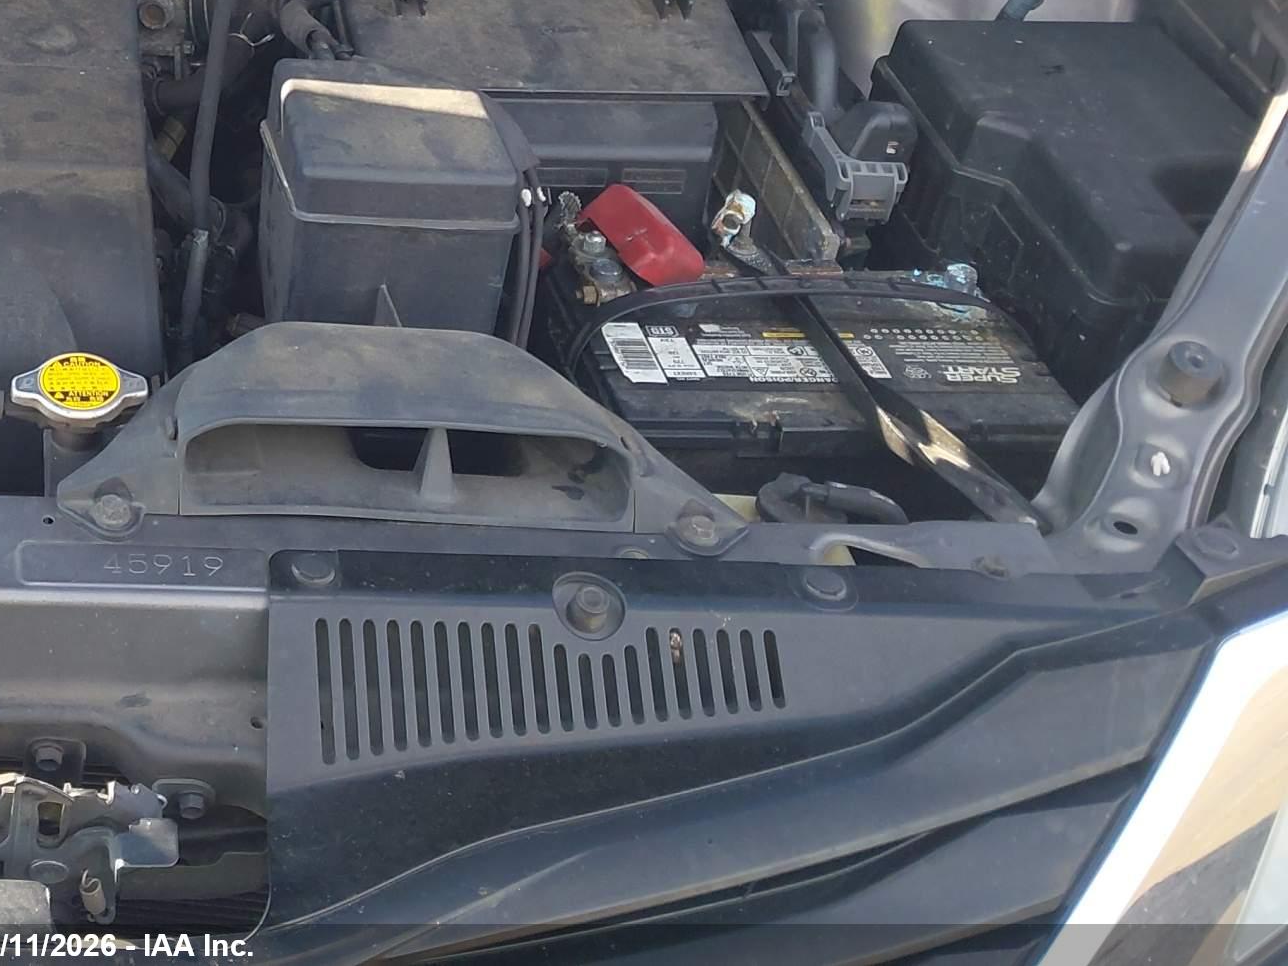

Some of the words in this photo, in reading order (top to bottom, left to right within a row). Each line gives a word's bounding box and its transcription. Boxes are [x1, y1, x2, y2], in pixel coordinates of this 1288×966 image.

[943, 365, 1021, 378] START
[946, 373, 1018, 384] SUPER
[103, 553, 224, 577] 45919
